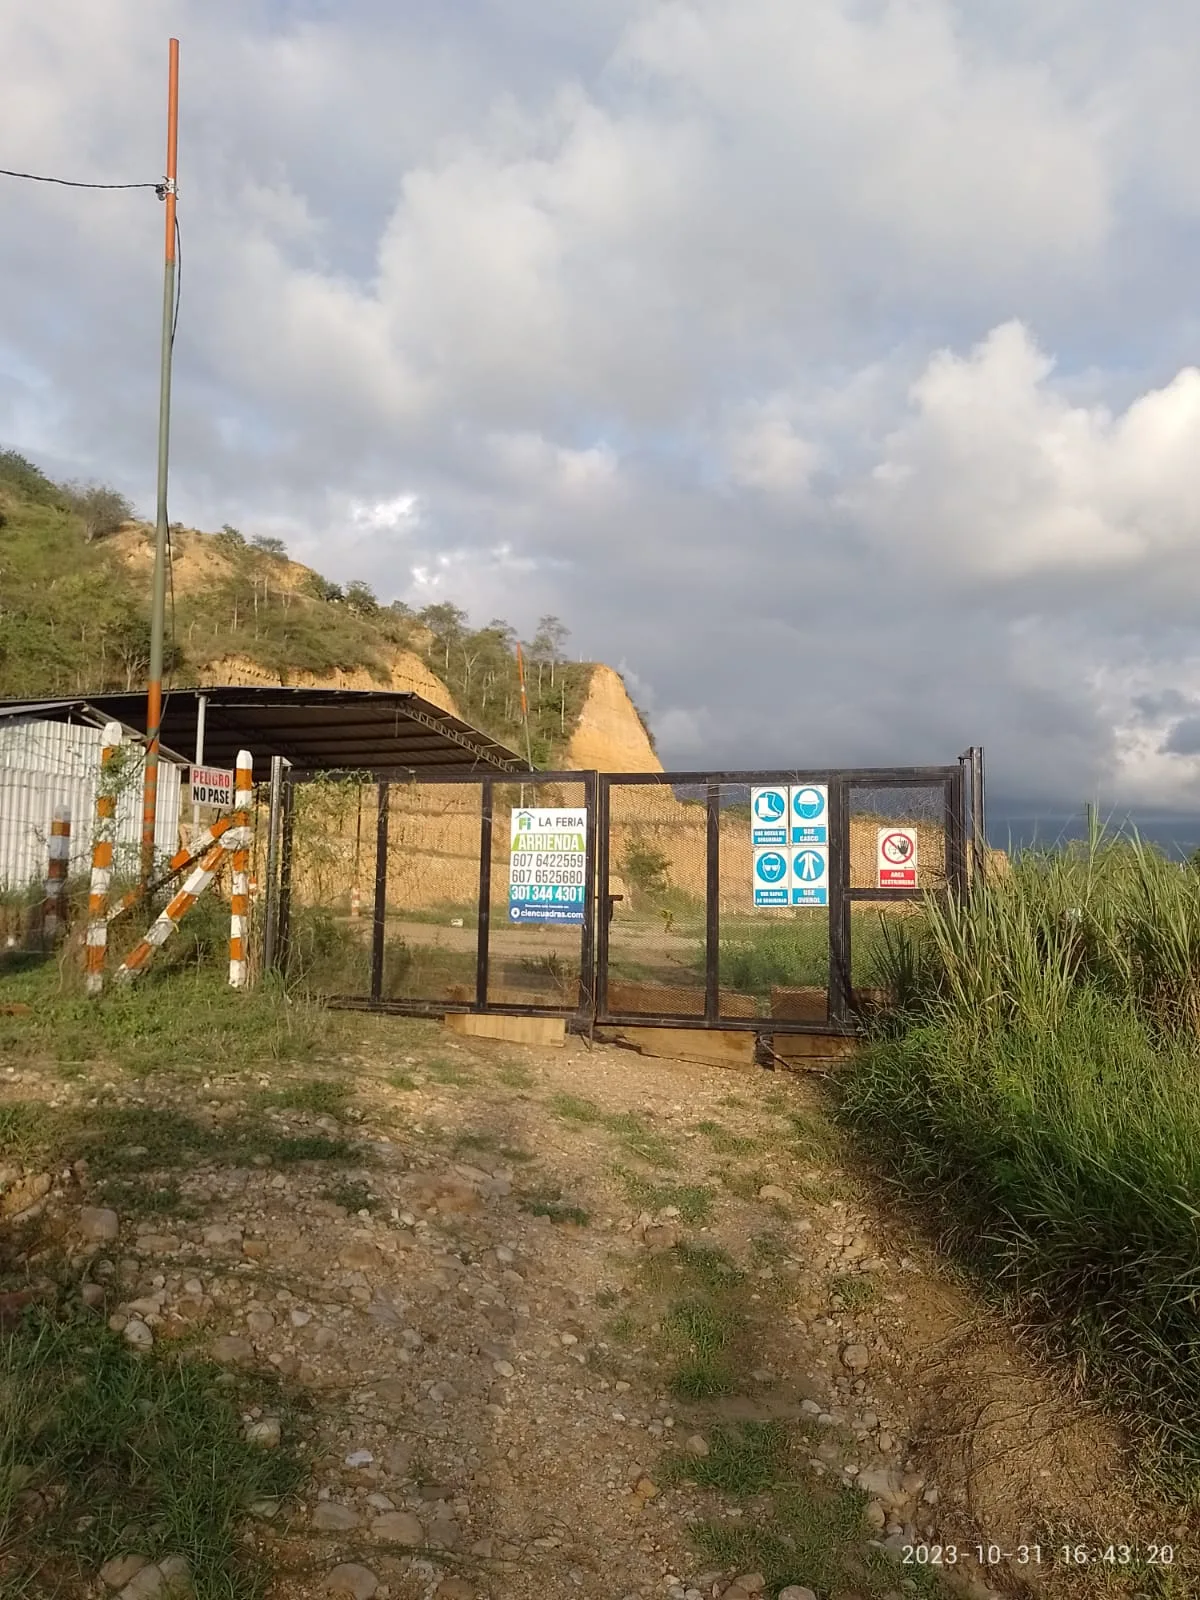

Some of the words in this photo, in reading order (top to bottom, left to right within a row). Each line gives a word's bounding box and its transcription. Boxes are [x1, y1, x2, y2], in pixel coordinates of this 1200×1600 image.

[193, 770, 230, 788] PELIGRO
[193, 786, 206, 802] NO
[208, 788, 230, 804] PASE
[538, 817, 552, 827] LA
[556, 817, 584, 827] FERIA
[519, 834, 580, 851] ARRIENDA
[513, 854, 533, 867] 607
[536, 854, 584, 868] 6422559
[512, 870, 532, 883] 607
[535, 870, 582, 884] 6525680
[511, 886, 530, 900] 301
[532, 886, 552, 900] 344
[555, 886, 583, 902] 4301
[521, 909, 584, 918] ciencuadras.com
